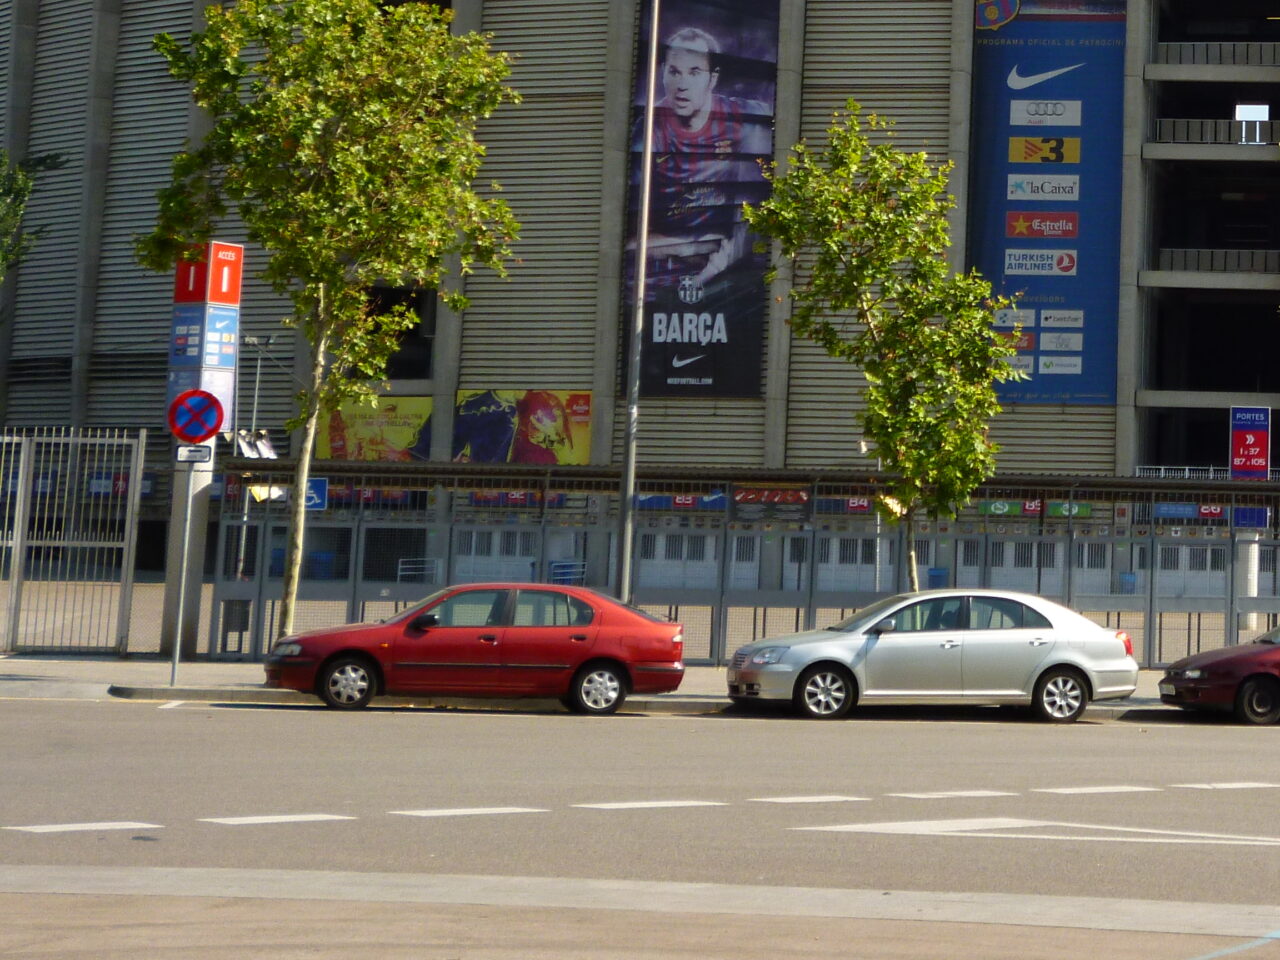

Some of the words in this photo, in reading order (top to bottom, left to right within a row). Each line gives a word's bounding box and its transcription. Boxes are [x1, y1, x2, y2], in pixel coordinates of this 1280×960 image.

[1040, 138, 1064, 163] 3
[1032, 219, 1073, 235] Estrella
[1007, 253, 1054, 262] TURKISH
[1006, 262, 1054, 271] AIRLINES
[653, 312, 728, 346] BARÇA
[1236, 412, 1265, 421] PORTES
[1249, 447, 1260, 455] 37
[1233, 457, 1246, 465] 87
[1251, 458, 1266, 466] 105
[849, 497, 868, 507] 84
